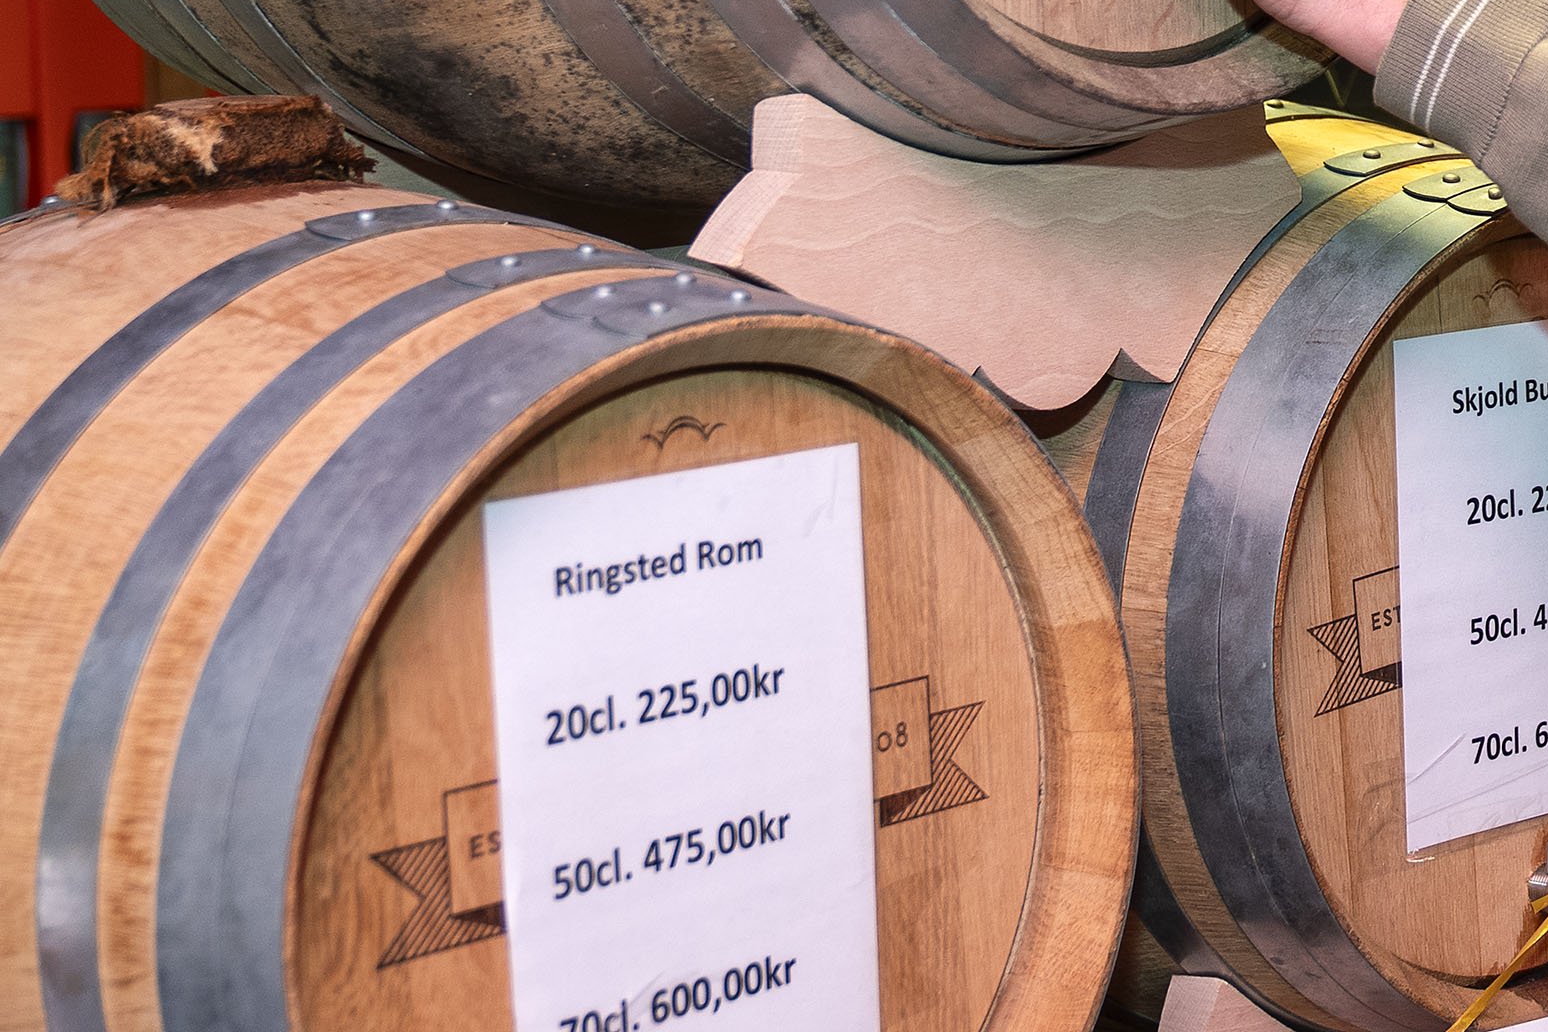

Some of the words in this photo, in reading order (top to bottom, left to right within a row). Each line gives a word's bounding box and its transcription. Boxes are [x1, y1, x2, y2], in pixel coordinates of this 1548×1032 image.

[1453, 379, 1518, 416] Skjold
[1466, 489, 1524, 525] 20cl.
[554, 542, 687, 597] Ringsted
[697, 537, 763, 570] Rom
[1470, 608, 1526, 646] 50cl.
[546, 694, 627, 746] 20cl.
[638, 663, 785, 724] 225,00kr
[1471, 726, 1527, 764] 70cl.
[553, 847, 633, 900] 50cl.
[644, 810, 792, 873] 475,00kr
[652, 956, 797, 1024] 600,00kr
